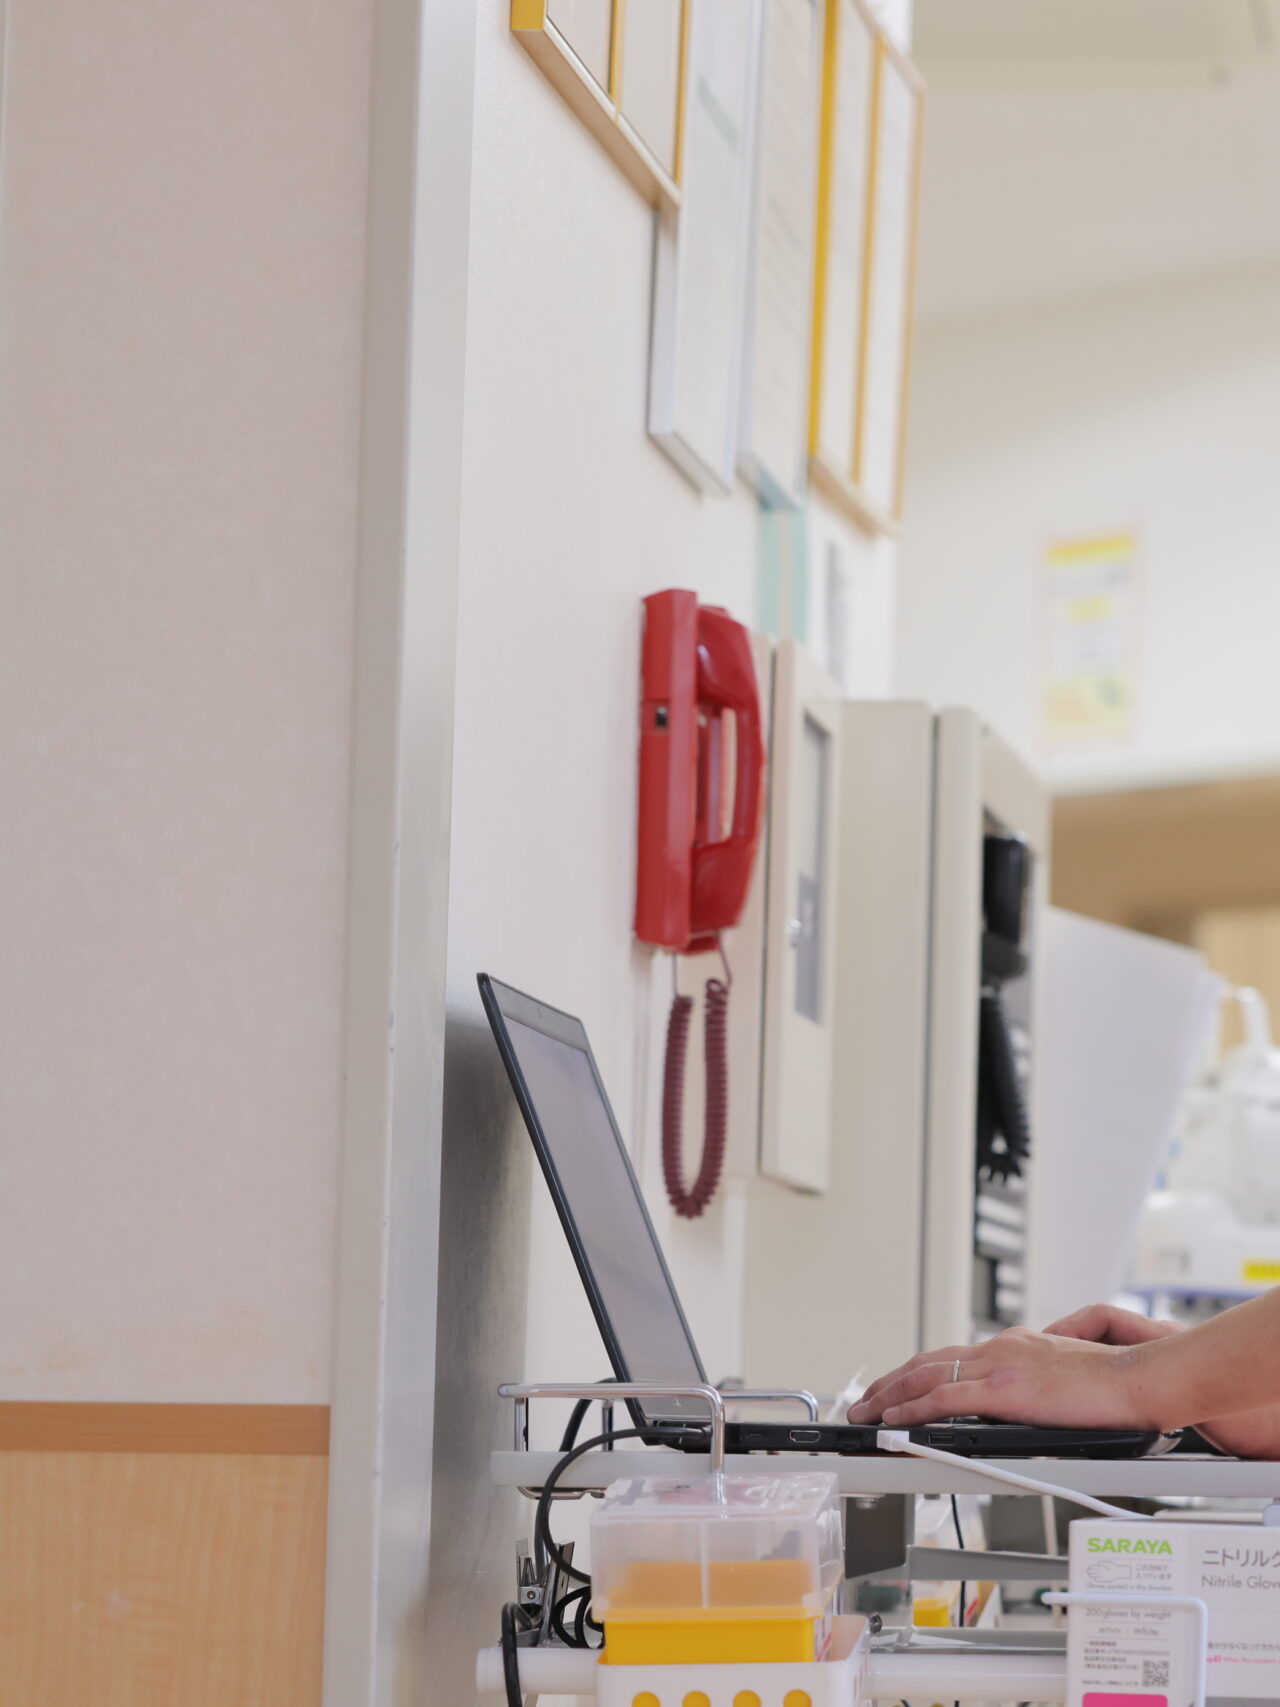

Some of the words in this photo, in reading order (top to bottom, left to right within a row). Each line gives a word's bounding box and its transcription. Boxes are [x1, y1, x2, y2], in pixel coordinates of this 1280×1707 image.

[1087, 1537, 1173, 1555] SARAYA
[1201, 1575, 1243, 1589] Nitrile
[1133, 1626, 1159, 1636] White
